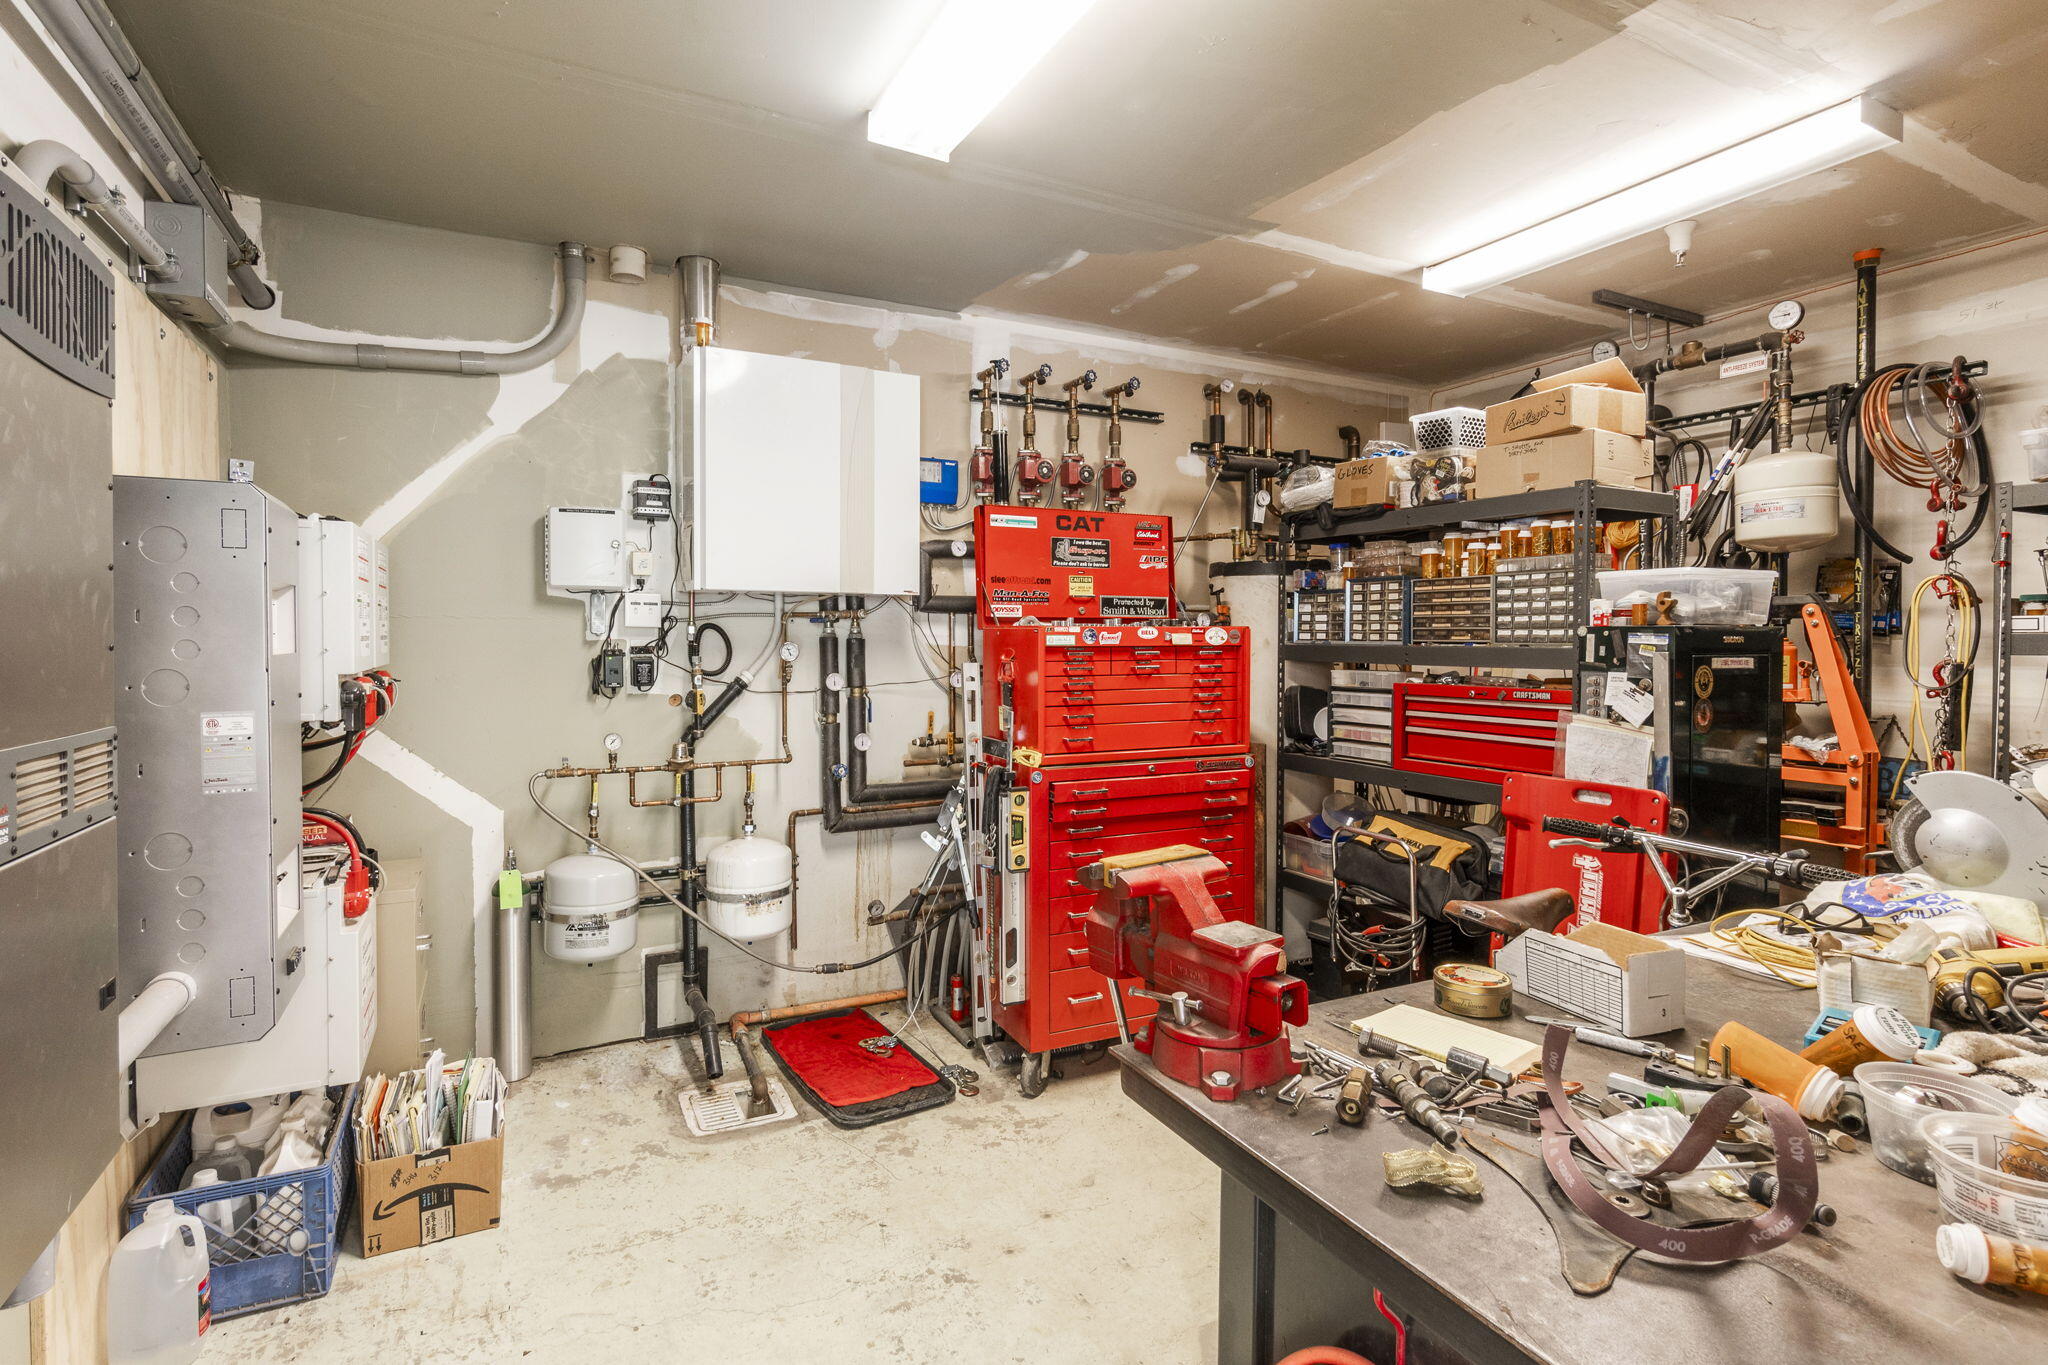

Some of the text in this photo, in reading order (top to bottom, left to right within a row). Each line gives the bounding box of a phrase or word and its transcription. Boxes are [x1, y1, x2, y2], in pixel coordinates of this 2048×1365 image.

[1748, 359, 1765, 369] SYSTEM
[1337, 463, 1374, 480] GLOVES
[1056, 515, 1105, 532] CAT
[1855, 557, 1863, 603] ANTI
[1102, 606, 1129, 615] Smith
[1130, 607, 1136, 615] &
[1113, 598, 1154, 607] Protected by
[1512, 691, 1551, 700] CRAFTSMAN
[1550, 1051, 1559, 1072] 400
[1788, 1136, 1805, 1163] 400
[1749, 1214, 1794, 1244] P-GRADE
[1658, 1238, 1686, 1253] 400
